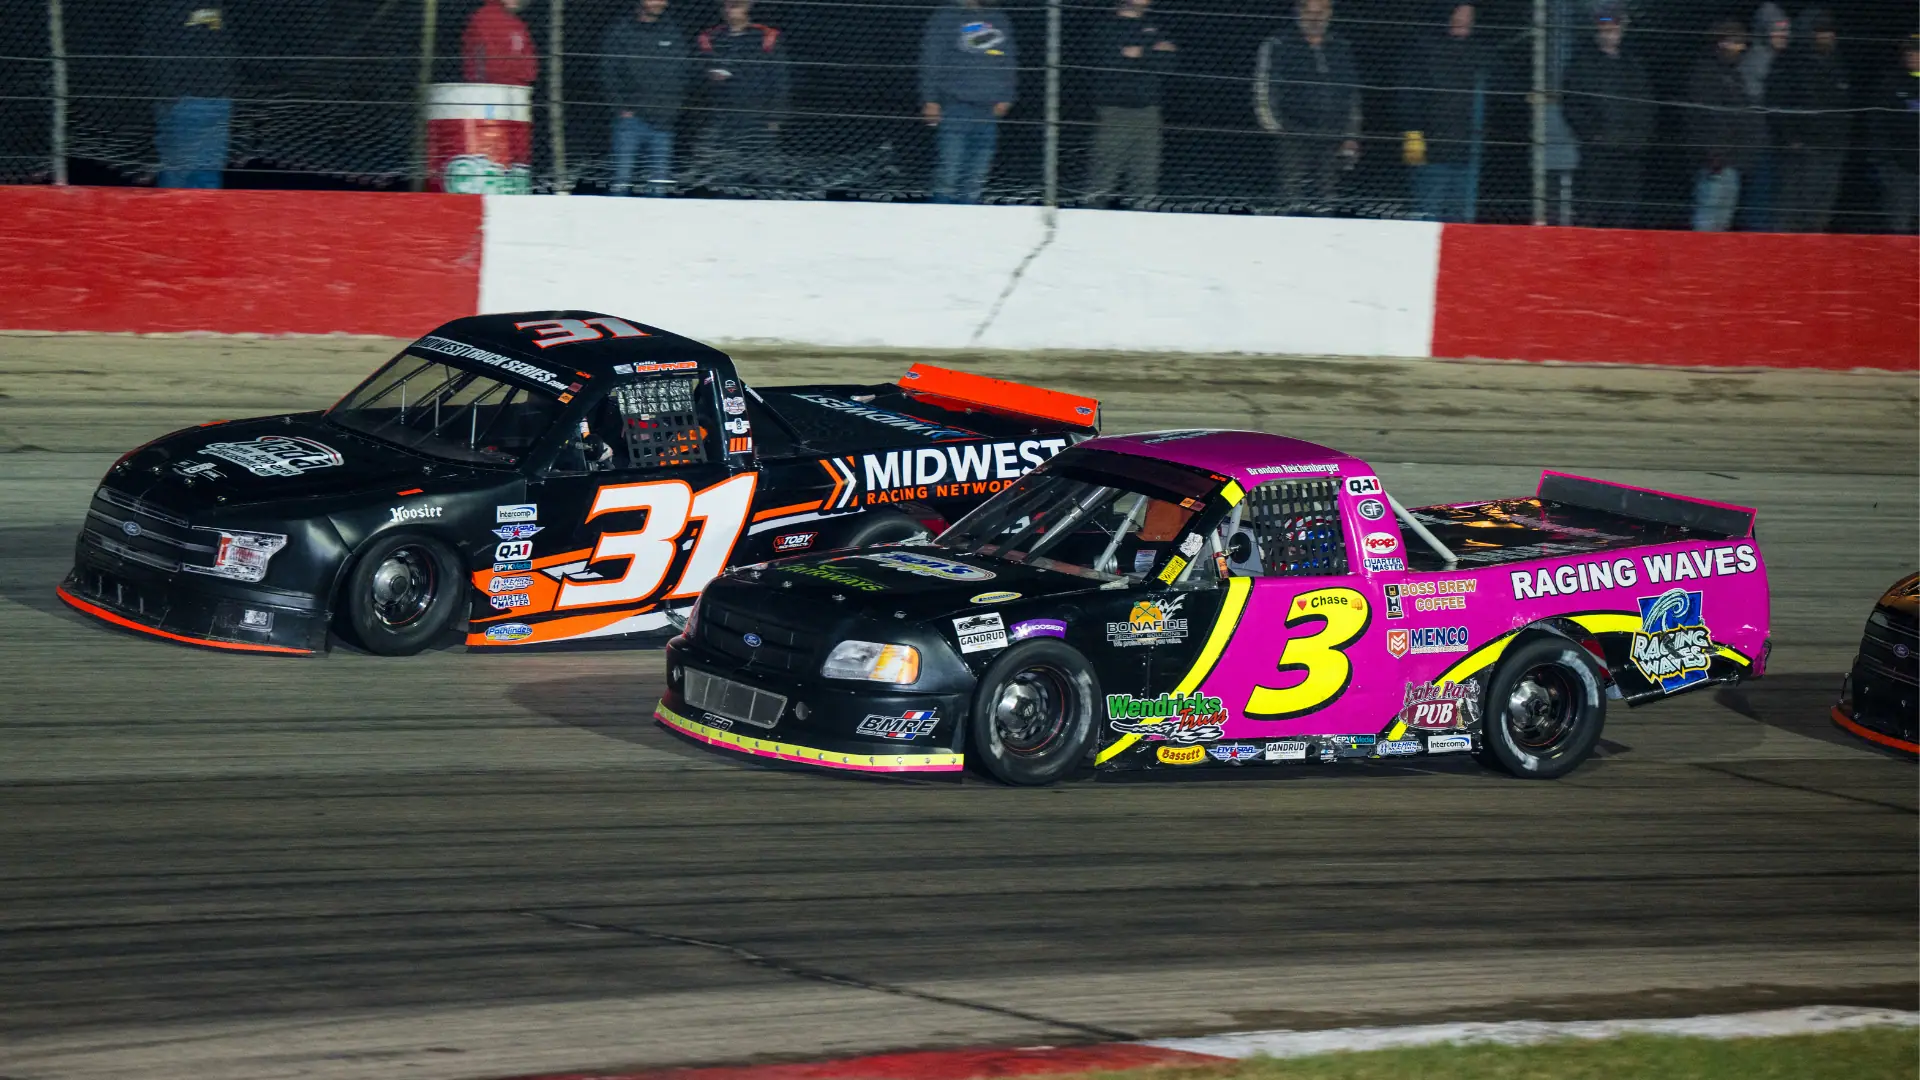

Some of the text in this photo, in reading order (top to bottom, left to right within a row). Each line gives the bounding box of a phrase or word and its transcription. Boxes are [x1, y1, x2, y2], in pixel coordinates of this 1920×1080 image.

[514, 318, 652, 349] 31
[460, 345, 509, 367] TRUCK
[864, 438, 1067, 491] MIDWEST
[1246, 465, 1283, 476] Brandon
[866, 479, 1016, 504] RACING NETWOR
[1349, 478, 1380, 494] QA1
[390, 503, 443, 523] Hoosier
[499, 509, 532, 520] Intercomp
[1361, 502, 1382, 517] GF
[501, 524, 535, 533] FIVE STAR
[553, 471, 759, 611] 31
[784, 533, 814, 545] TOBY
[498, 543, 530, 558] QA1
[1363, 557, 1401, 569] QUARTER
[1372, 563, 1404, 572] MASTER
[1510, 544, 1759, 600] RAGING WAVES
[1400, 579, 1477, 597] BOSS BREW
[491, 593, 528, 604] QUARTER
[498, 600, 529, 608] MASTER
[1311, 596, 1348, 608] Chase
[1415, 596, 1467, 611] COFFEE
[1028, 623, 1064, 633] HOOSIER
[1106, 618, 1189, 634] BONAFIDE
[960, 631, 1005, 646] GANDRUD
[1411, 626, 1468, 647] MENCO
[1243, 587, 1373, 722] 3
[1403, 680, 1479, 706] Lake Par
[1108, 693, 1221, 718] Wendricks
[1178, 707, 1228, 731] Truss
[1413, 702, 1454, 725] PUB
[858, 714, 939, 735] BMRE
[1217, 746, 1255, 754] FIVE STAR
[1266, 742, 1305, 752] GANDRUD
[1430, 740, 1466, 749] Intercomp
[1161, 747, 1201, 761] Bassett
